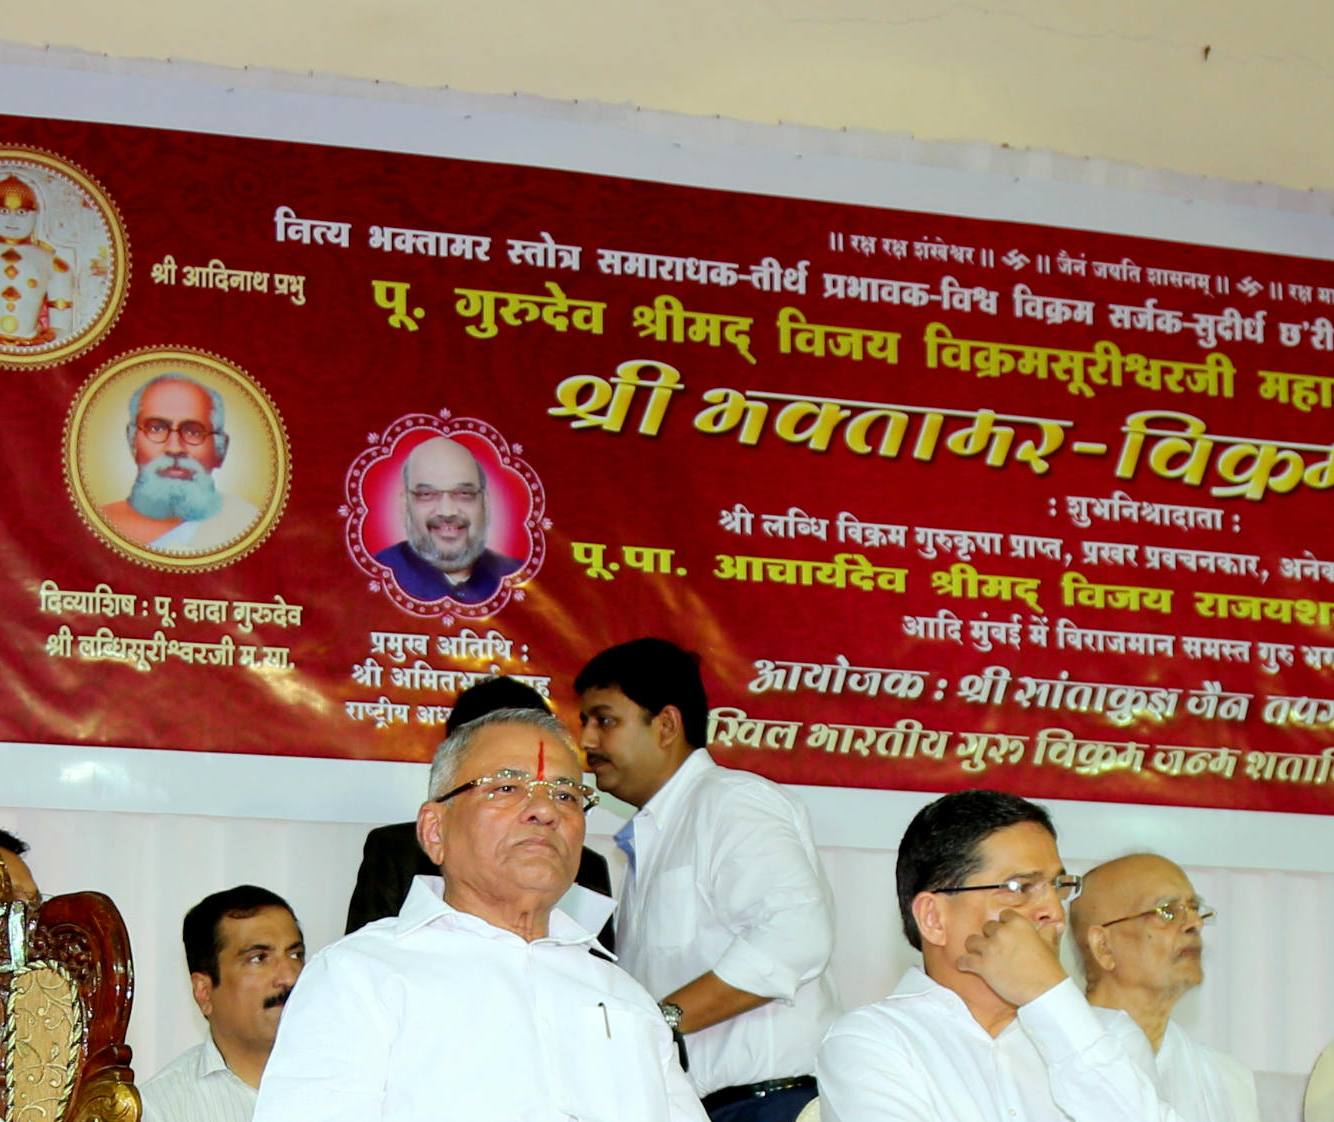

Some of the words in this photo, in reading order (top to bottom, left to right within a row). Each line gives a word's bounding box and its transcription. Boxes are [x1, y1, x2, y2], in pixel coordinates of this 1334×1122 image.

[151, 256, 177, 283] श्री
[182, 262, 269, 294] आदिनाथ
[274, 273, 306, 304] प्रभु
[275, 205, 350, 248] नित्य
[369, 223, 491, 262] भक्तामर
[507, 231, 581, 272] स्तोत्र
[597, 247, 809, 296] समाराधक-तीर्थ
[823, 271, 999, 315] प्रभावक-विश्व
[1014, 284, 1094, 327] विक्रम
[850, 235, 876, 257] रक्ष
[882, 237, 908, 260] रक्ष
[1056, 251, 1087, 277] जैनं
[1092, 257, 1141, 282] जयति
[1147, 267, 1213, 298] शासनम्
[1288, 283, 1313, 304] रक्ष
[372, 279, 427, 332] पू.
[454, 281, 607, 340] गुरुदेव
[633, 295, 759, 364] श्रीमद्
[776, 306, 901, 365] विजय
[924, 321, 1236, 399] विक्रमसूरीश्वरजी
[547, 358, 685, 437] श्री
[719, 503, 754, 537] श्री
[762, 506, 829, 540] लब्धि
[837, 512, 908, 549] विक्रम
[915, 525, 1002, 561] गुरुकृपा
[1082, 540, 1138, 566] प्रखर
[40, 579, 138, 617] दिव्याशिष
[154, 596, 177, 629] पू.
[183, 599, 227, 624] दादा
[233, 597, 302, 632] गुरुदेव
[570, 540, 688, 580] पू.पा.
[713, 552, 908, 594] आचार्यदेव
[931, 563, 1045, 614] श्रीमद्
[1061, 571, 1173, 614] विजय
[46, 632, 73, 658] श्री
[239, 645, 294, 670] म.सा.
[351, 657, 384, 687] श्री
[370, 632, 430, 662] प्रमुख
[436, 628, 514, 661] अतिथि
[902, 608, 963, 645] आदि
[970, 611, 1022, 651] मुंबई
[1030, 615, 1049, 648] में
[1182, 635, 1251, 663] समस्त
[1258, 644, 1295, 674] गुरु
[345, 696, 410, 729] राष्ट्रीय
[748, 655, 930, 701] आयोजक
[957, 665, 1013, 705] श्री
[1187, 681, 1255, 721] जैन
[708, 706, 804, 751] खिल
[807, 716, 953, 760] भारतीय
[956, 730, 1029, 773] गुरु
[1034, 728, 1149, 776] विक्रम
[1152, 744, 1241, 780] जन्म
